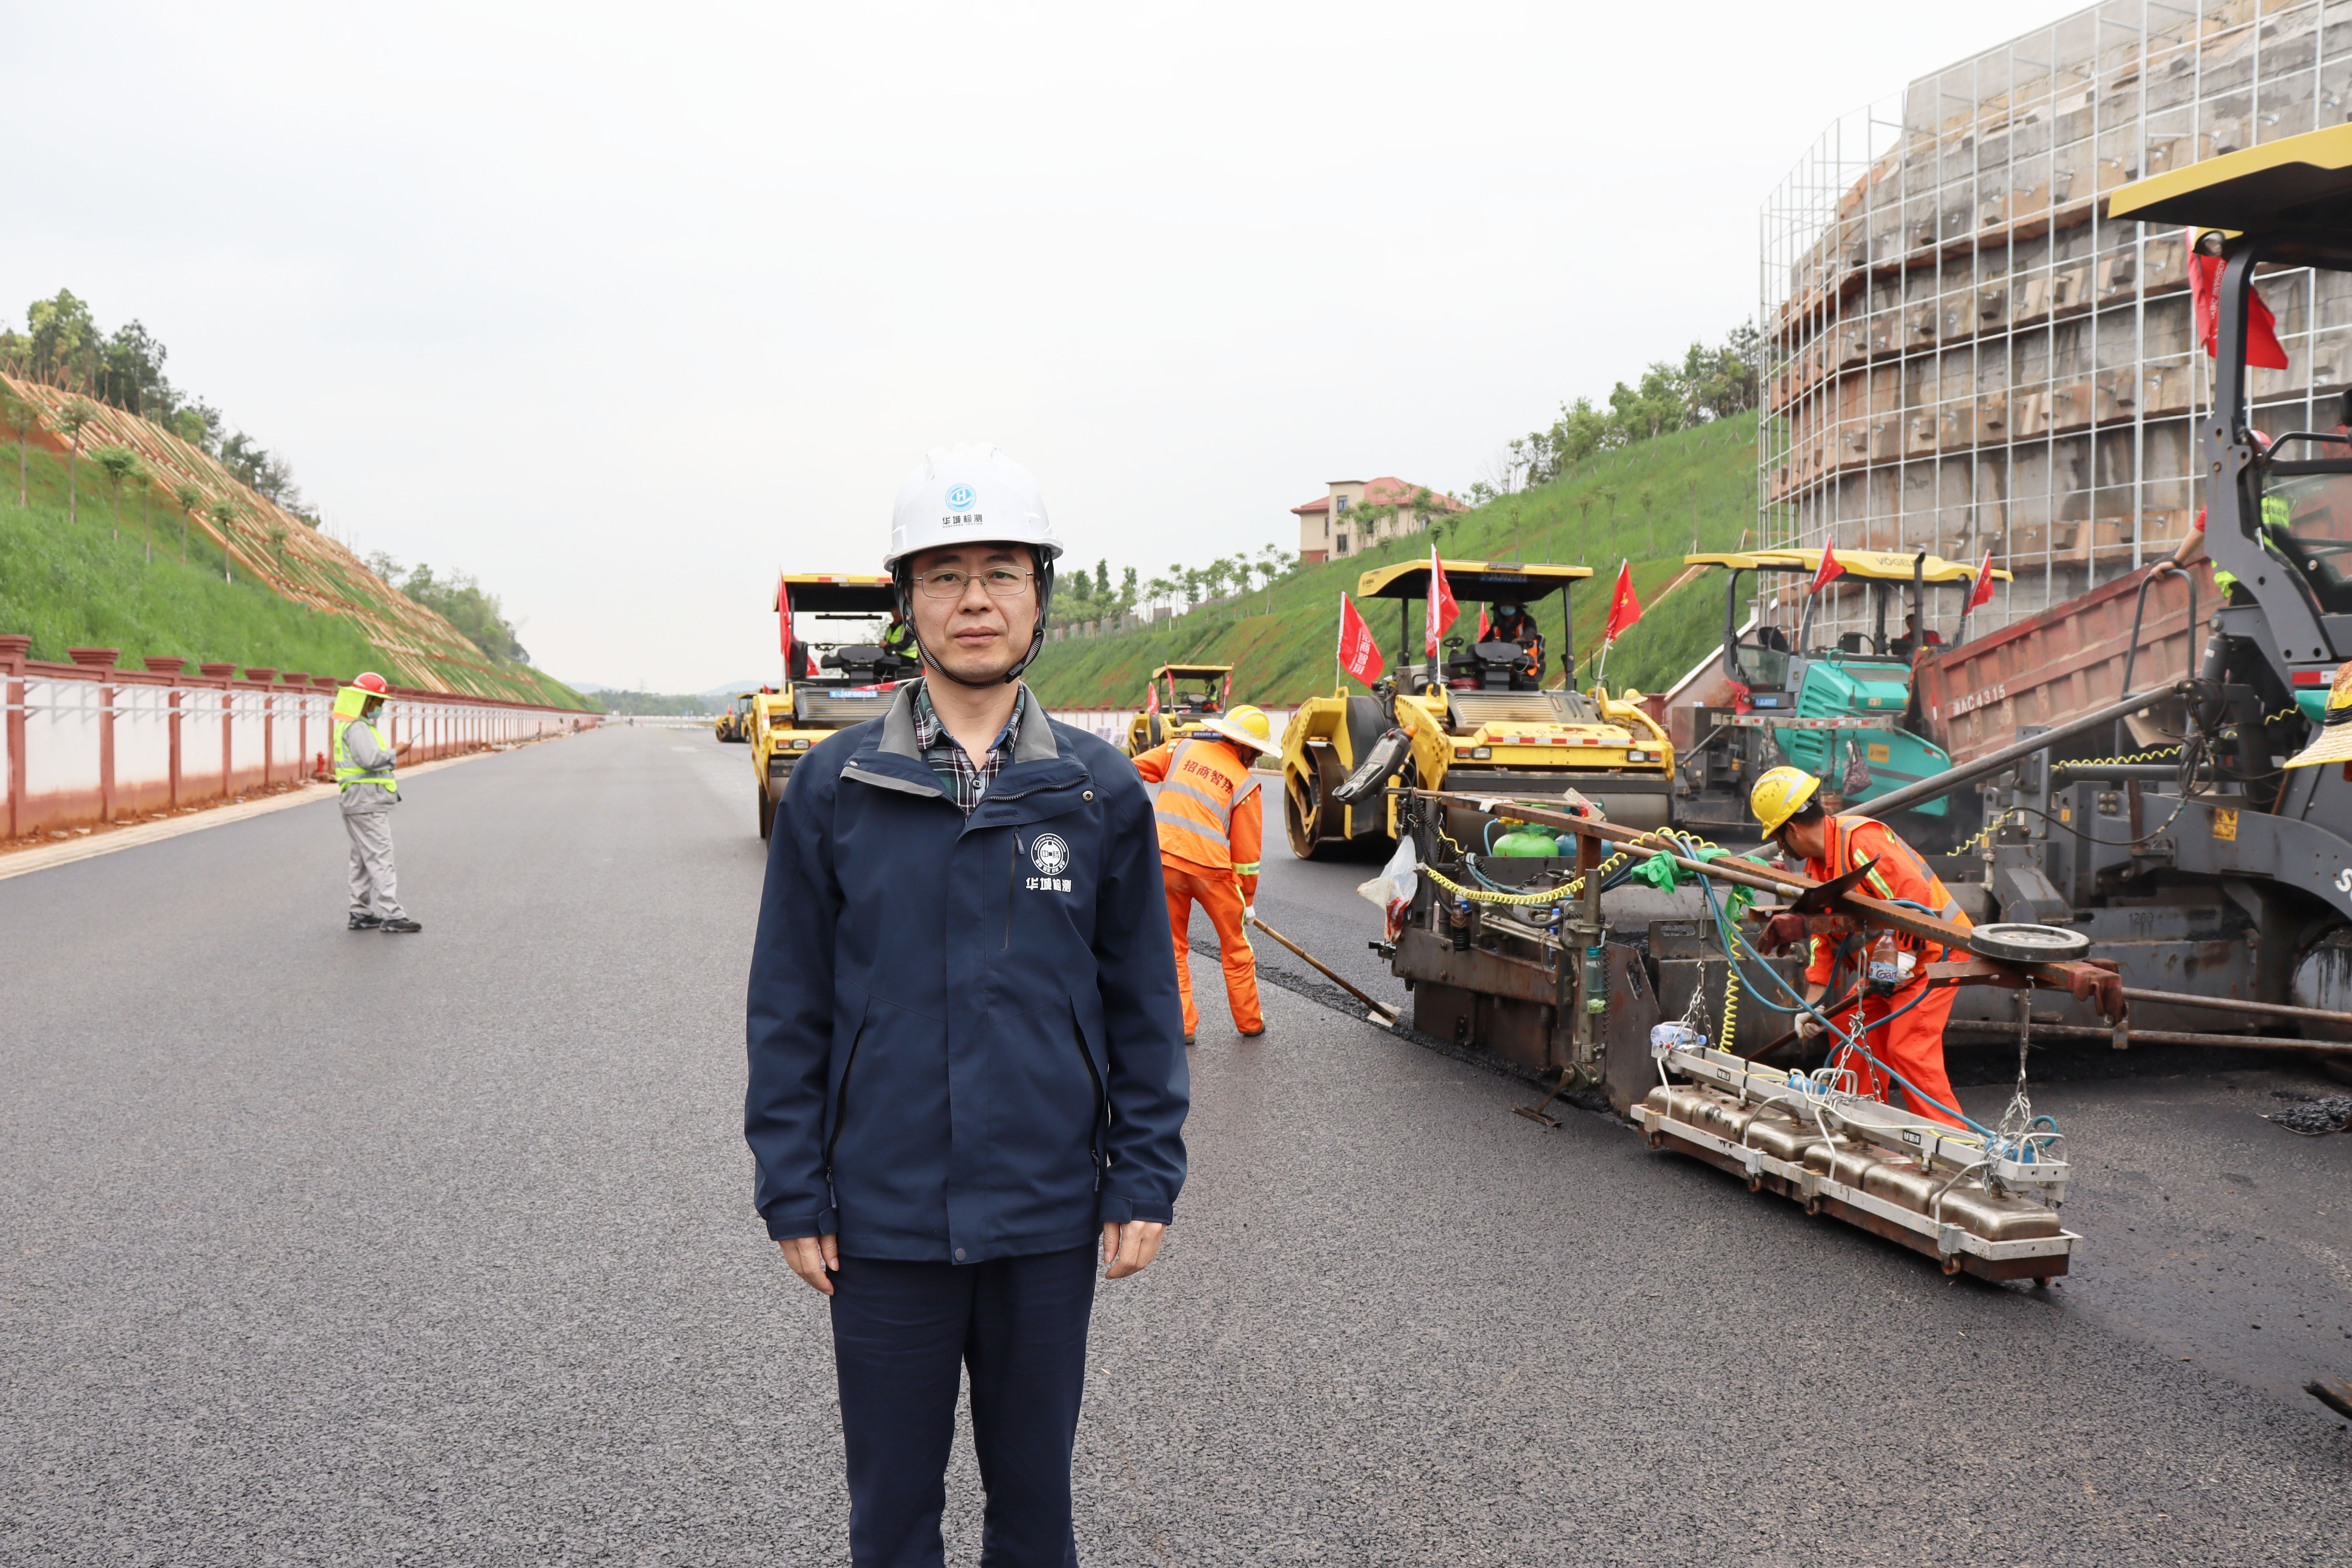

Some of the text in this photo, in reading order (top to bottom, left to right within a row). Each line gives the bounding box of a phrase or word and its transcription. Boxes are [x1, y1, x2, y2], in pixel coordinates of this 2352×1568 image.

[942, 514, 982, 525] 华城检测
[1183, 759, 1234, 794] 招商智翔
[1026, 877, 1071, 893] 华城检测
